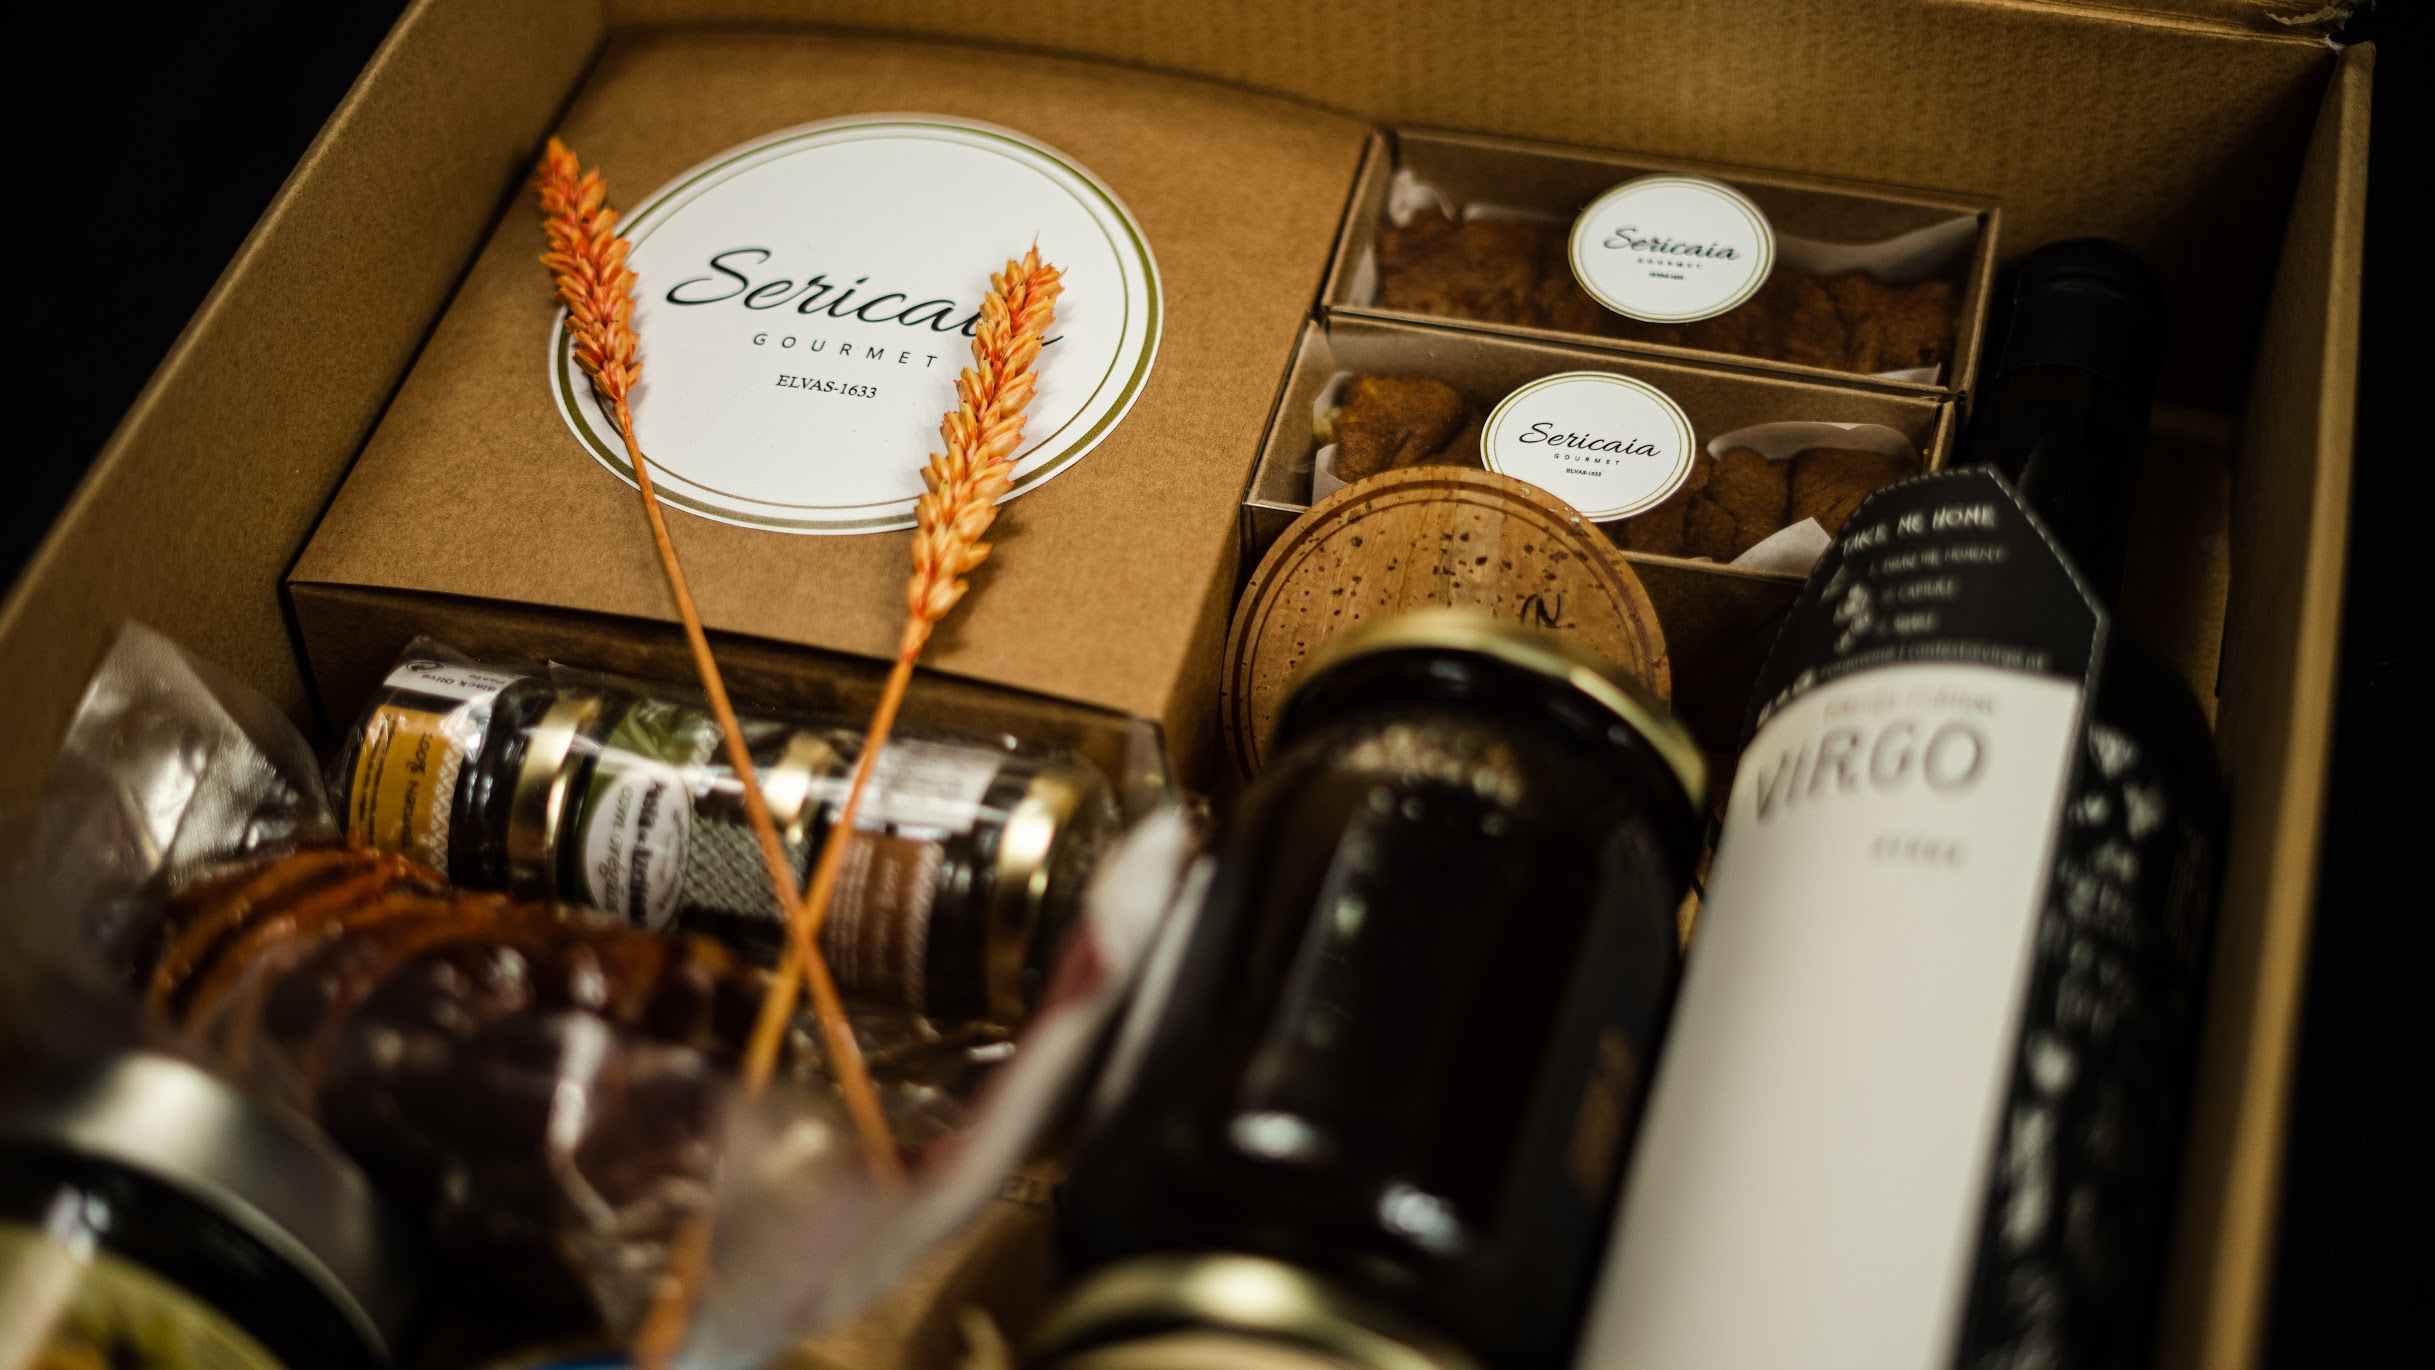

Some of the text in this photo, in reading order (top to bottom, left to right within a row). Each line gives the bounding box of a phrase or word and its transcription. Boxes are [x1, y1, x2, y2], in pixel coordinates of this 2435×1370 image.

[1603, 224, 1742, 262] Sericaia
[753, 332, 939, 369] GOURMET
[776, 373, 878, 400] ELVAS-1633
[1518, 421, 1662, 457] Sericaia
[1553, 452, 1621, 467] GOURMET
[1932, 503, 1997, 531] HOME
[1757, 719, 1988, 824] VIRGO
